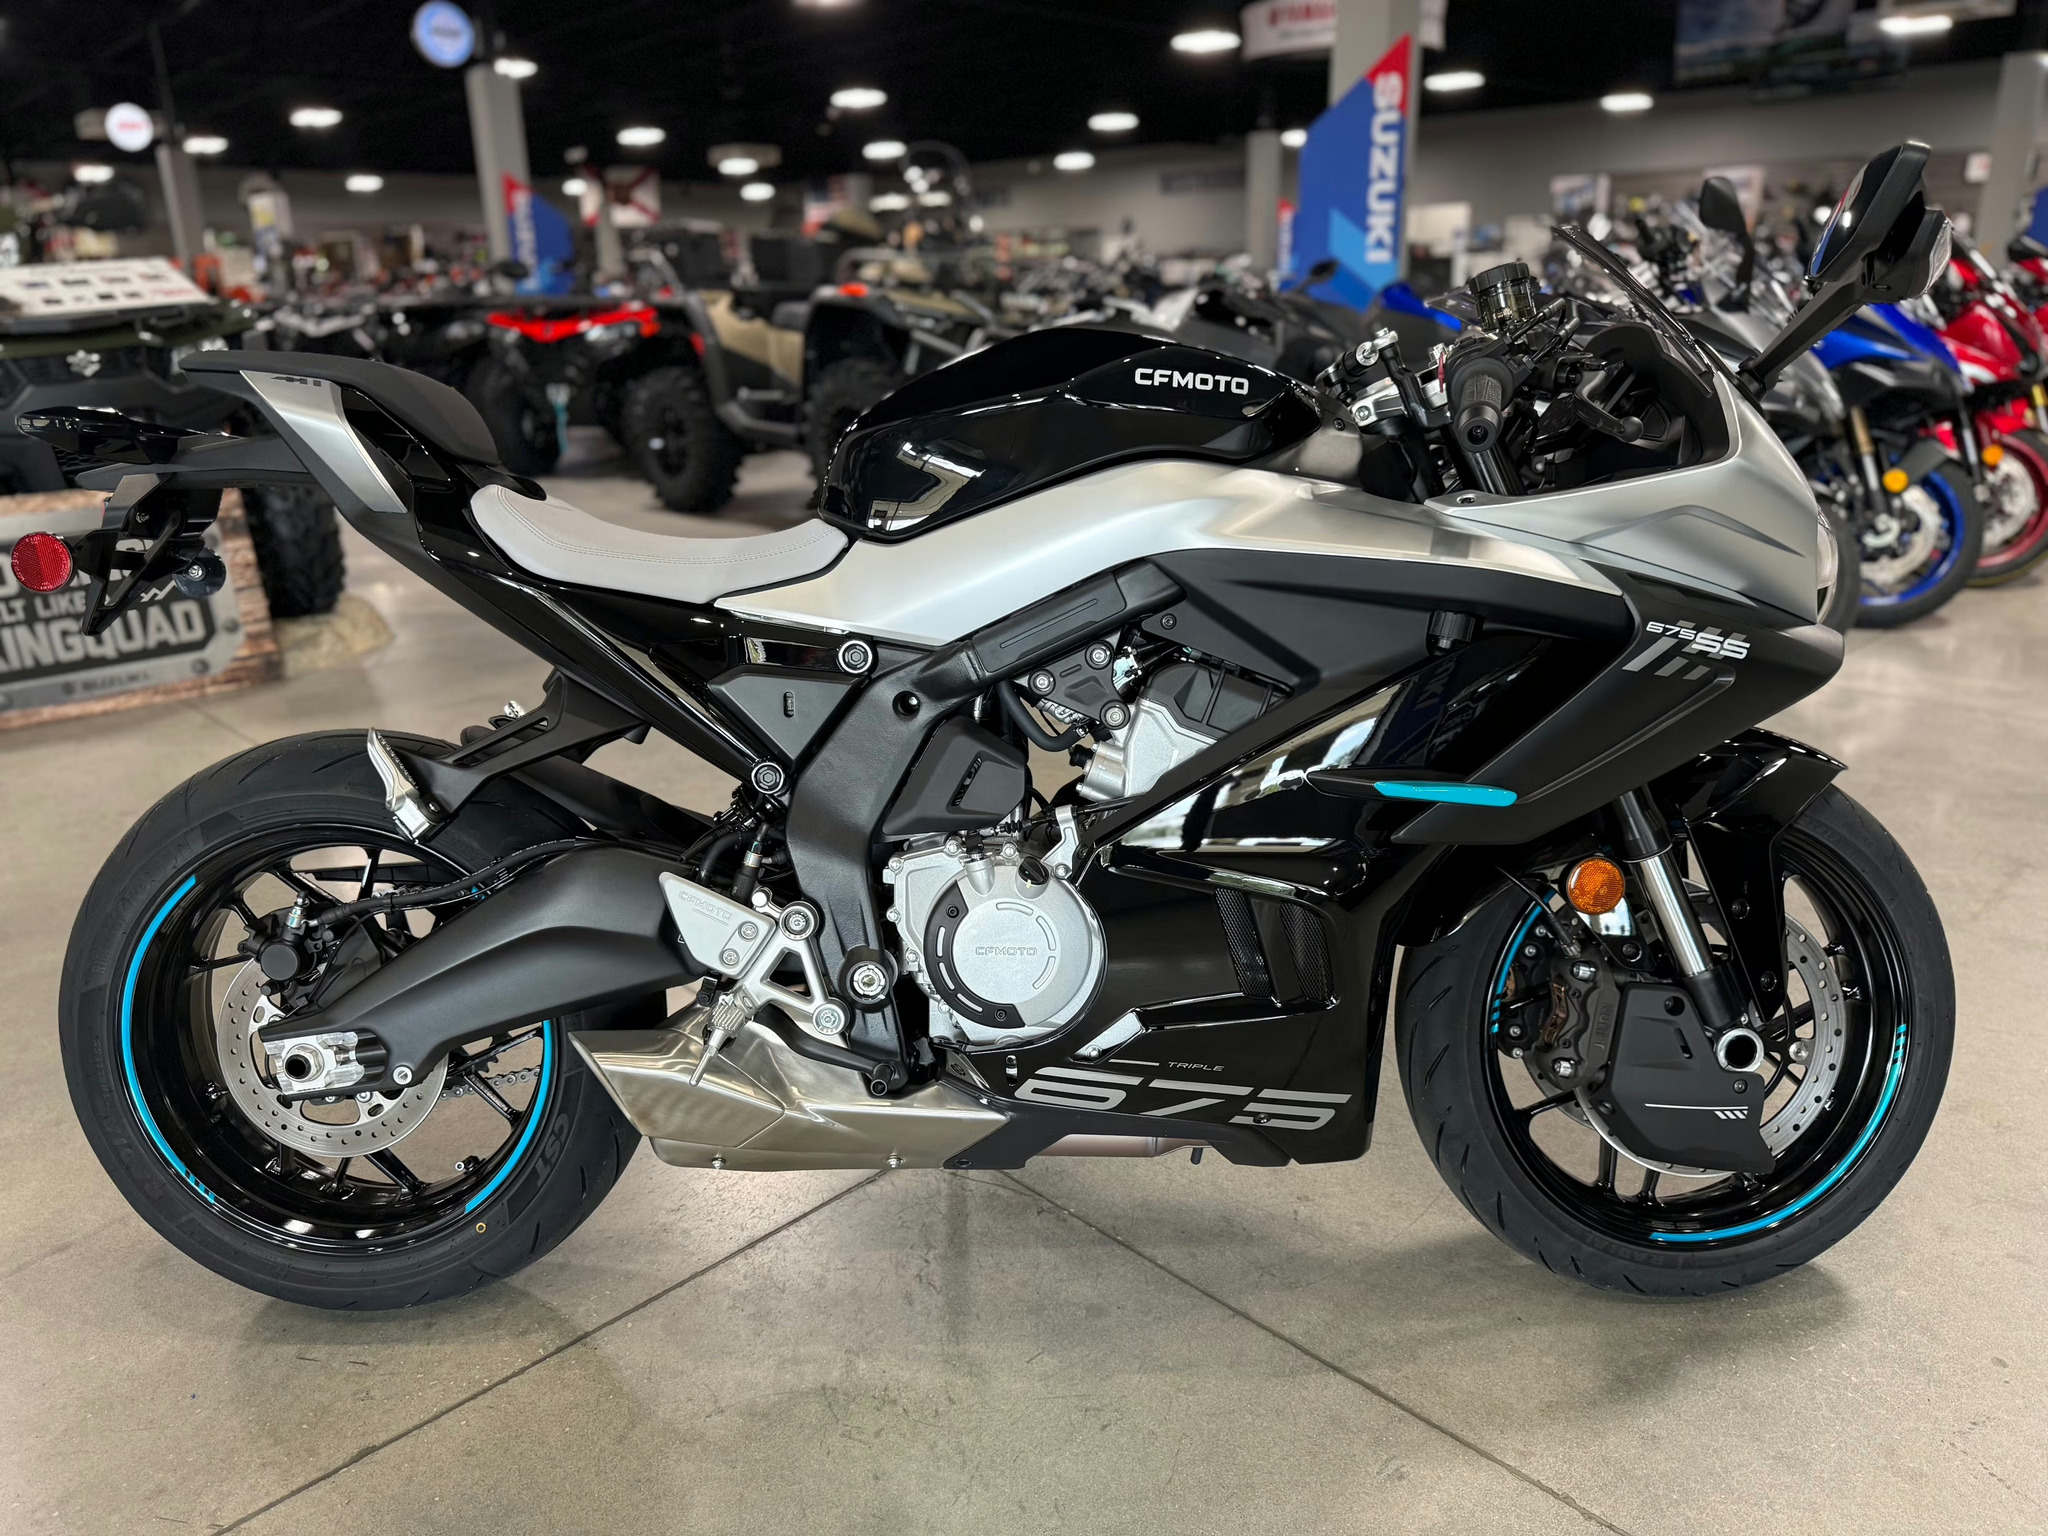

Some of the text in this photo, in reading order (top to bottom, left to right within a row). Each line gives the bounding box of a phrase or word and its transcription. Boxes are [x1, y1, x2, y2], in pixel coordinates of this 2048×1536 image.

[1364, 70, 1404, 265] SUZUKI
[1134, 367, 1250, 396] CFMOTO
[34, 590, 87, 620] LIKE
[0, 598, 207, 675] INGQUAD
[679, 889, 734, 921] CFMOTO
[975, 946, 1038, 957] CFMOTO
[1167, 1060, 1226, 1073] TRIPLE
[1013, 1065, 1353, 1132] 675
[535, 1112, 570, 1188] CST
